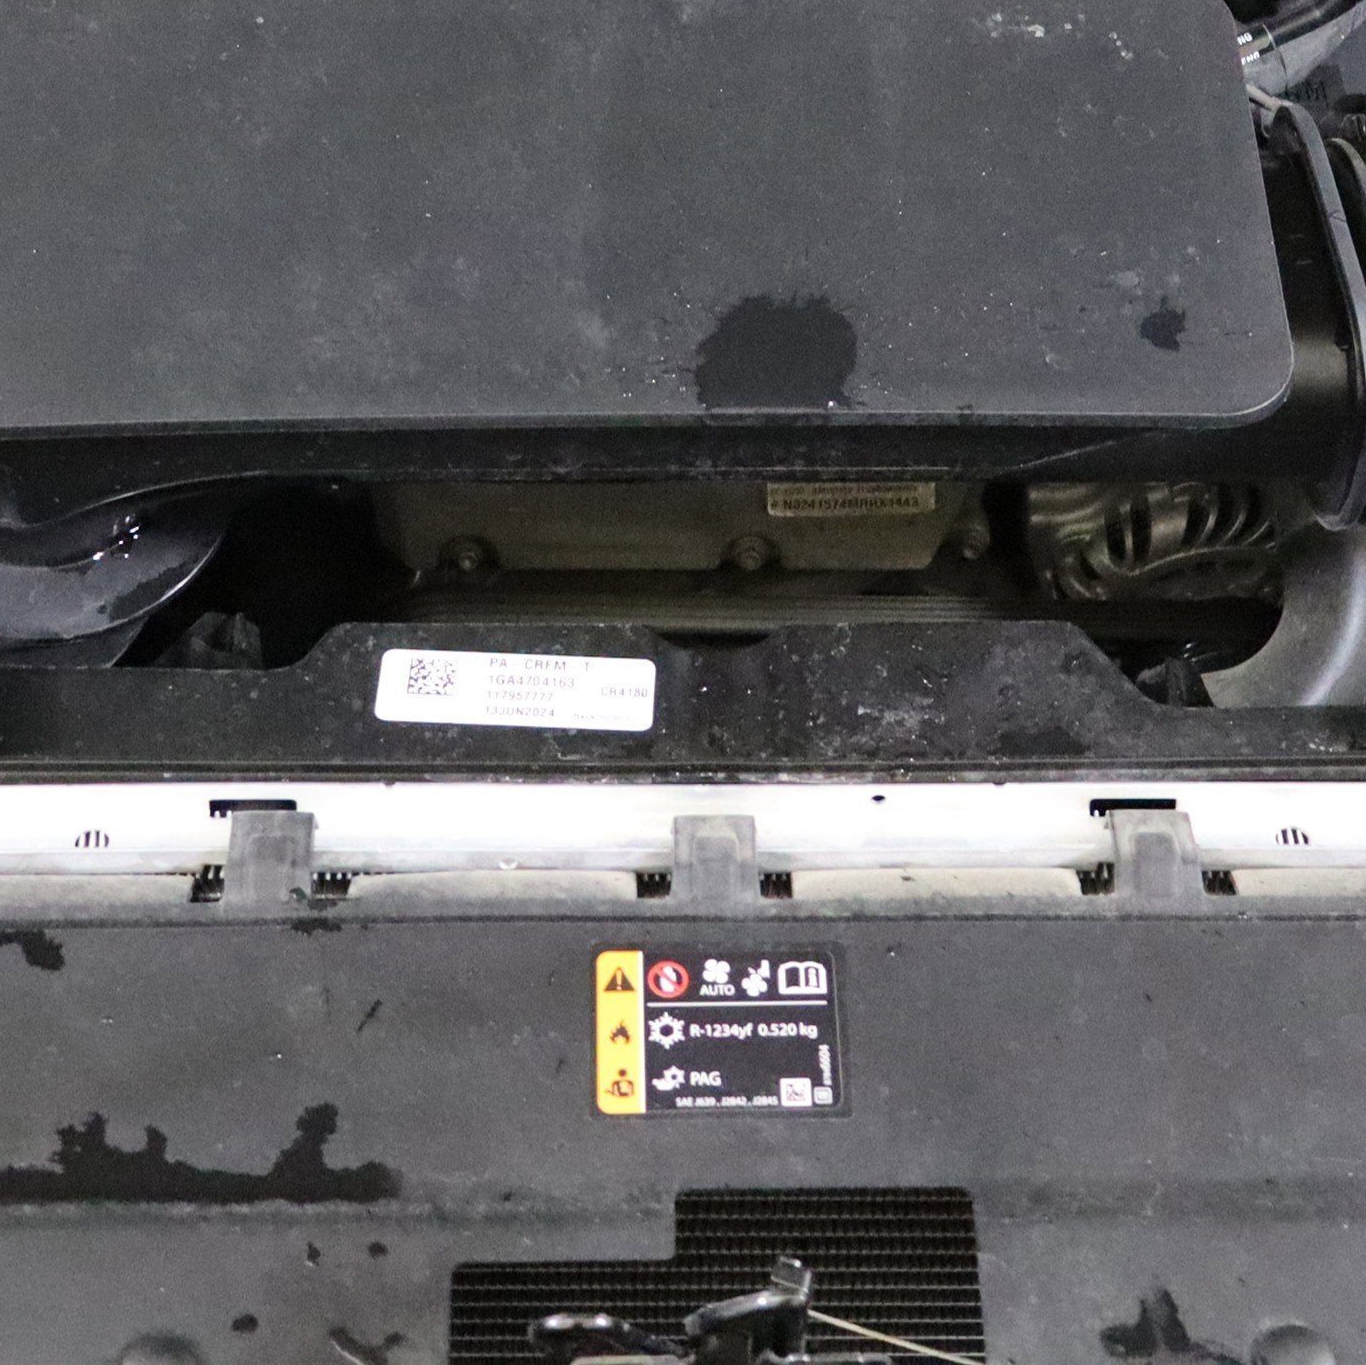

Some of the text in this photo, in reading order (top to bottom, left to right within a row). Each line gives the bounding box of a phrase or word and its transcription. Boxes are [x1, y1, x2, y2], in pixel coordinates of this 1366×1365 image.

[489, 657, 509, 669] PA
[699, 984, 736, 997] AUTO
[689, 1022, 818, 1040] R-1234yf 0.520 kg
[690, 1071, 722, 1087] PAG
